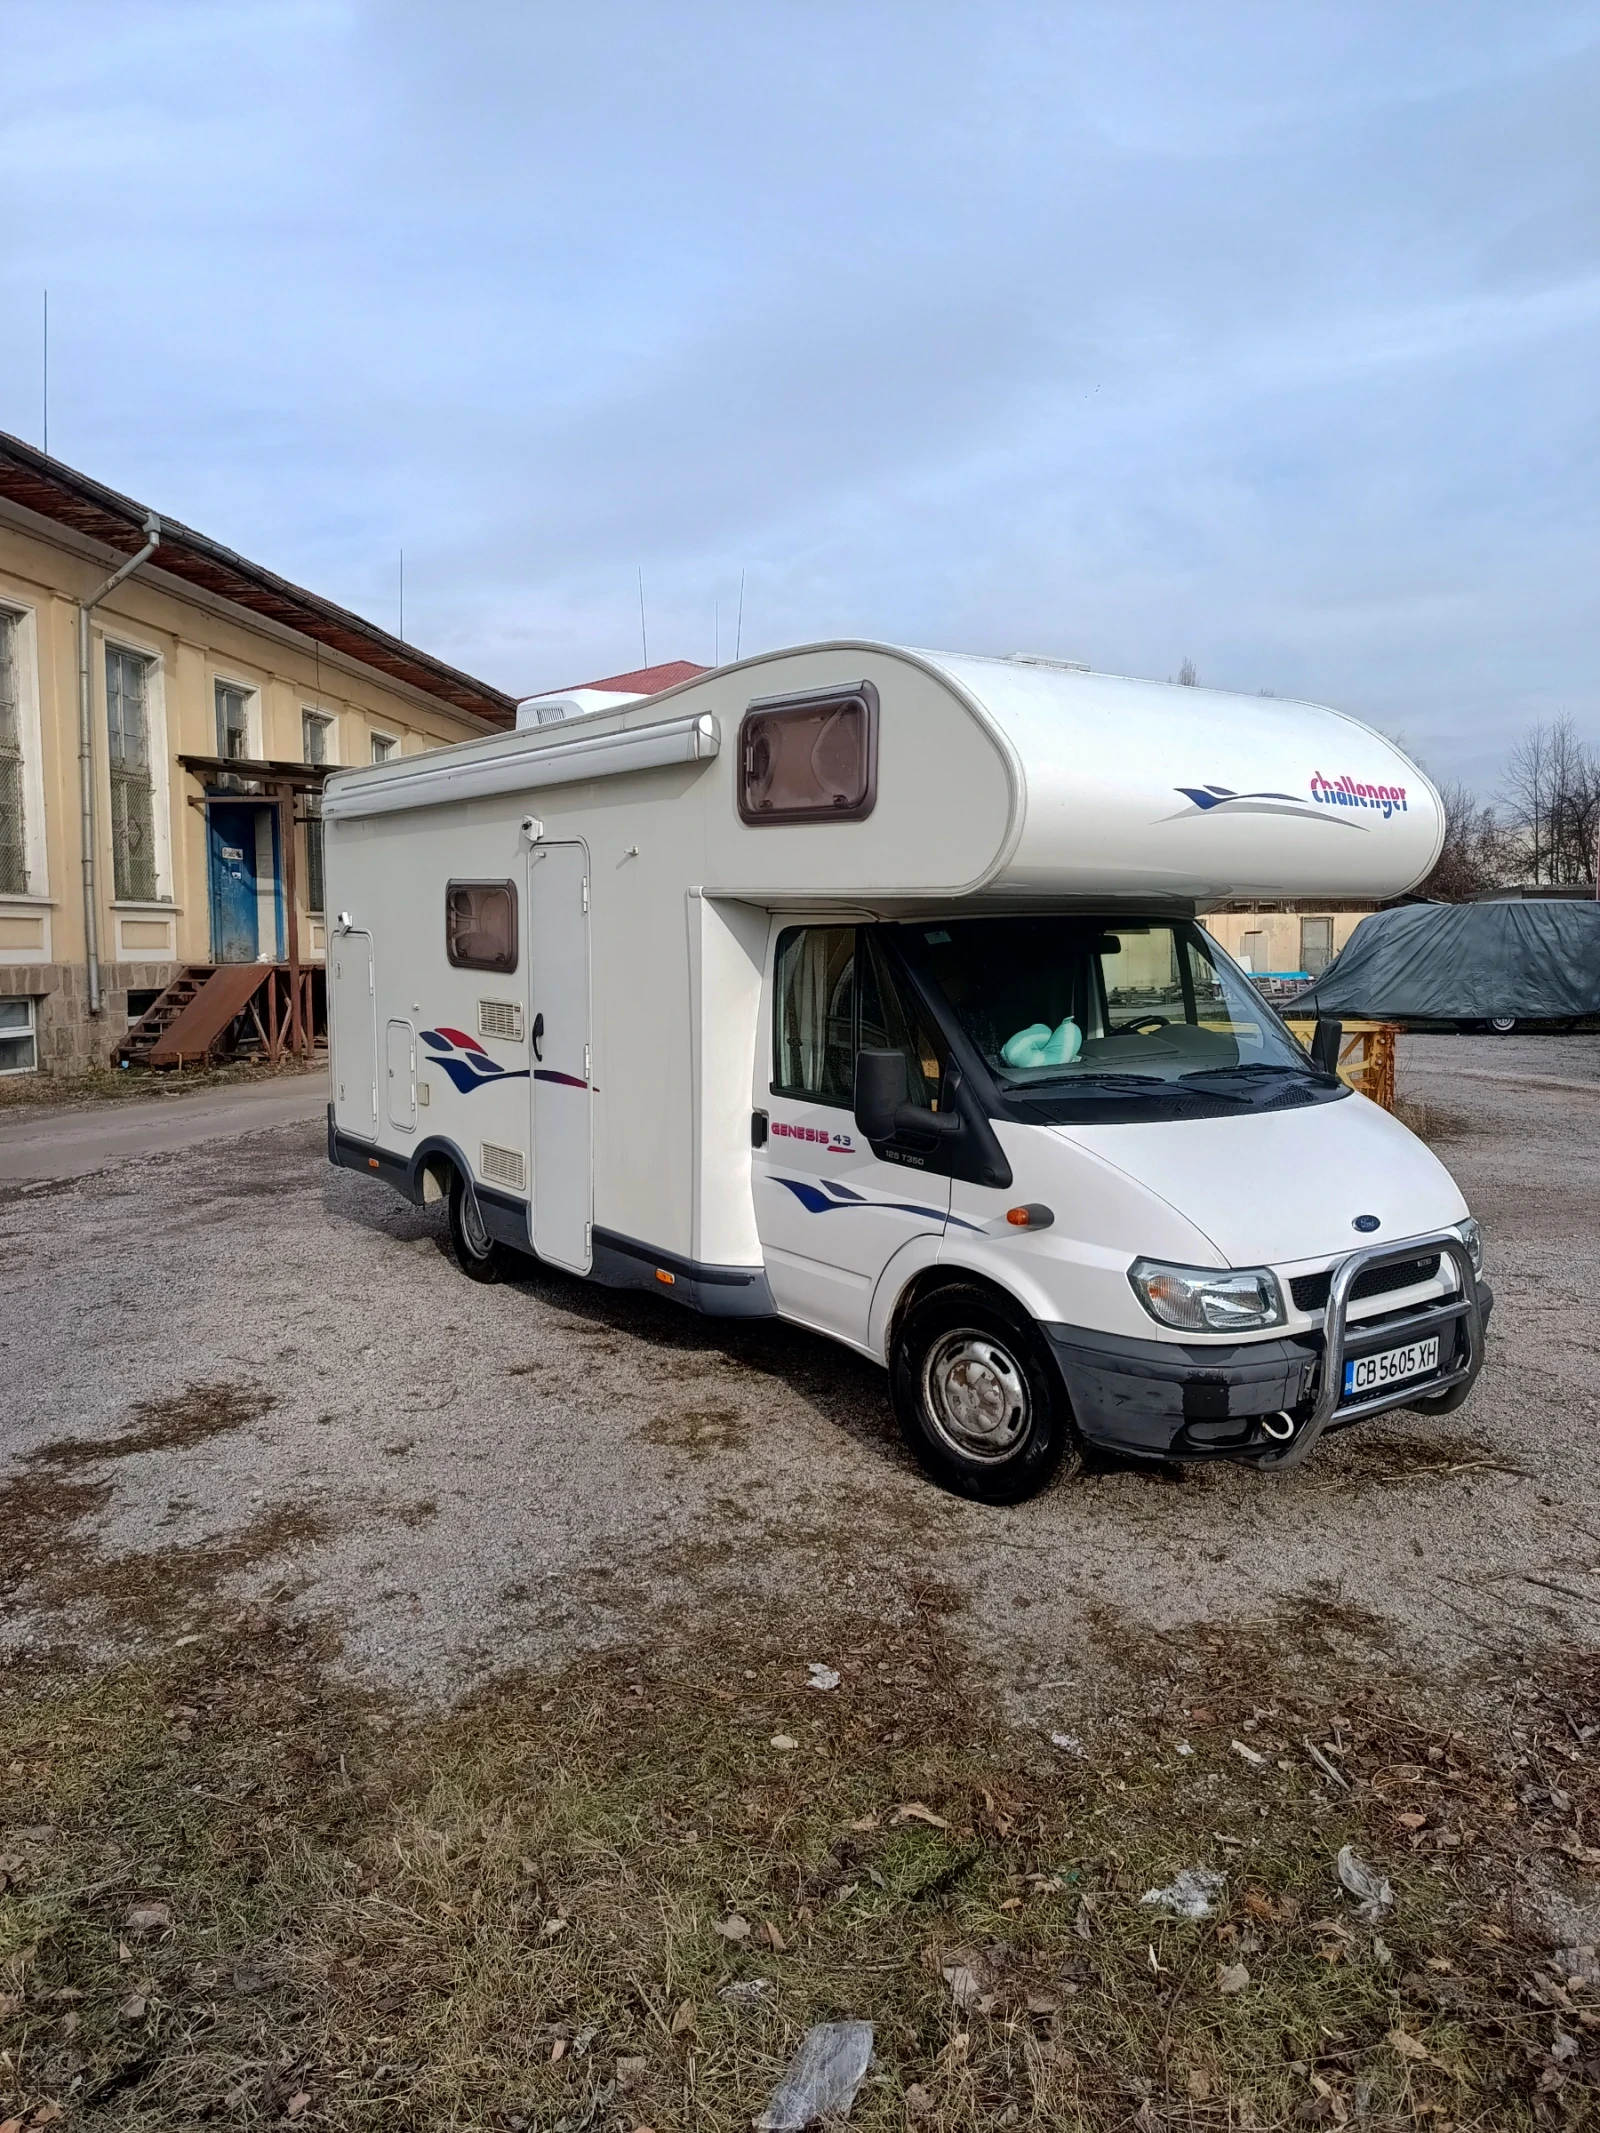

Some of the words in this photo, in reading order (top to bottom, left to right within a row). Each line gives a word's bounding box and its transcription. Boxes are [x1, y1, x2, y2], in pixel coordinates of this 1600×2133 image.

[771, 1122, 830, 1145] GENESIS
[832, 1134, 852, 1147] 43
[885, 1149, 900, 1160] 125
[901, 1153, 925, 1166] T350
[1356, 1360, 1377, 1388] CB
[1379, 1347, 1416, 1381] 5605
[1418, 1340, 1437, 1370] XH
